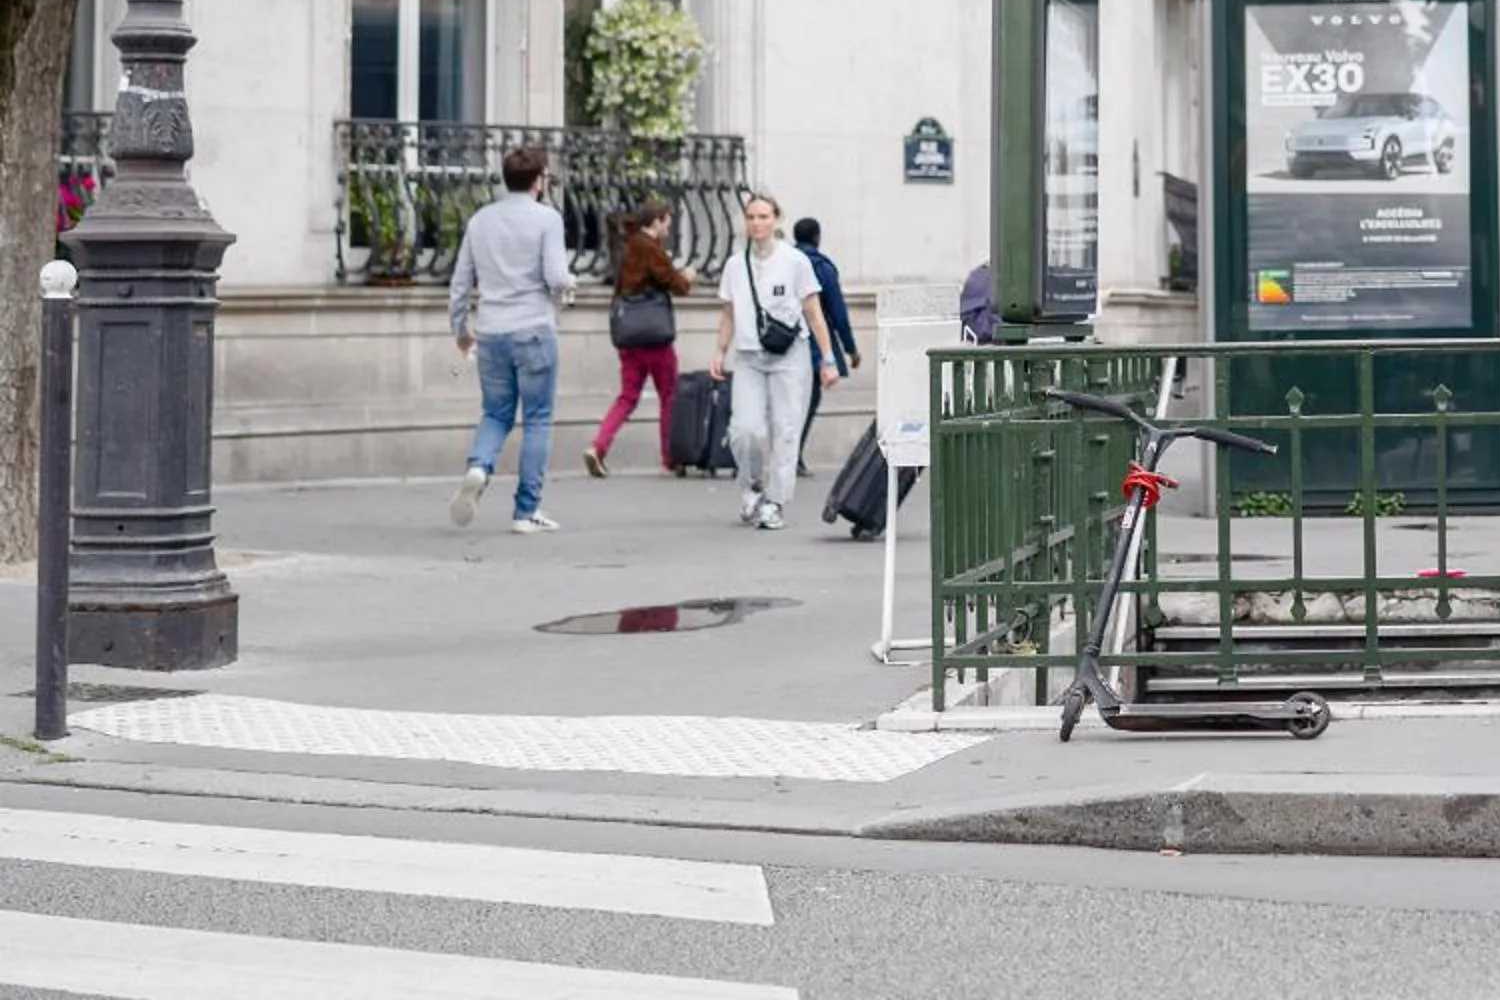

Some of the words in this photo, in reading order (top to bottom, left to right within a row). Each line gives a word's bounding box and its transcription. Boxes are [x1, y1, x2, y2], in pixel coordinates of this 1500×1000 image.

[1311, 13, 1401, 25] VOLVO
[1325, 49, 1364, 63] Volvo
[1261, 63, 1364, 93] EX30
